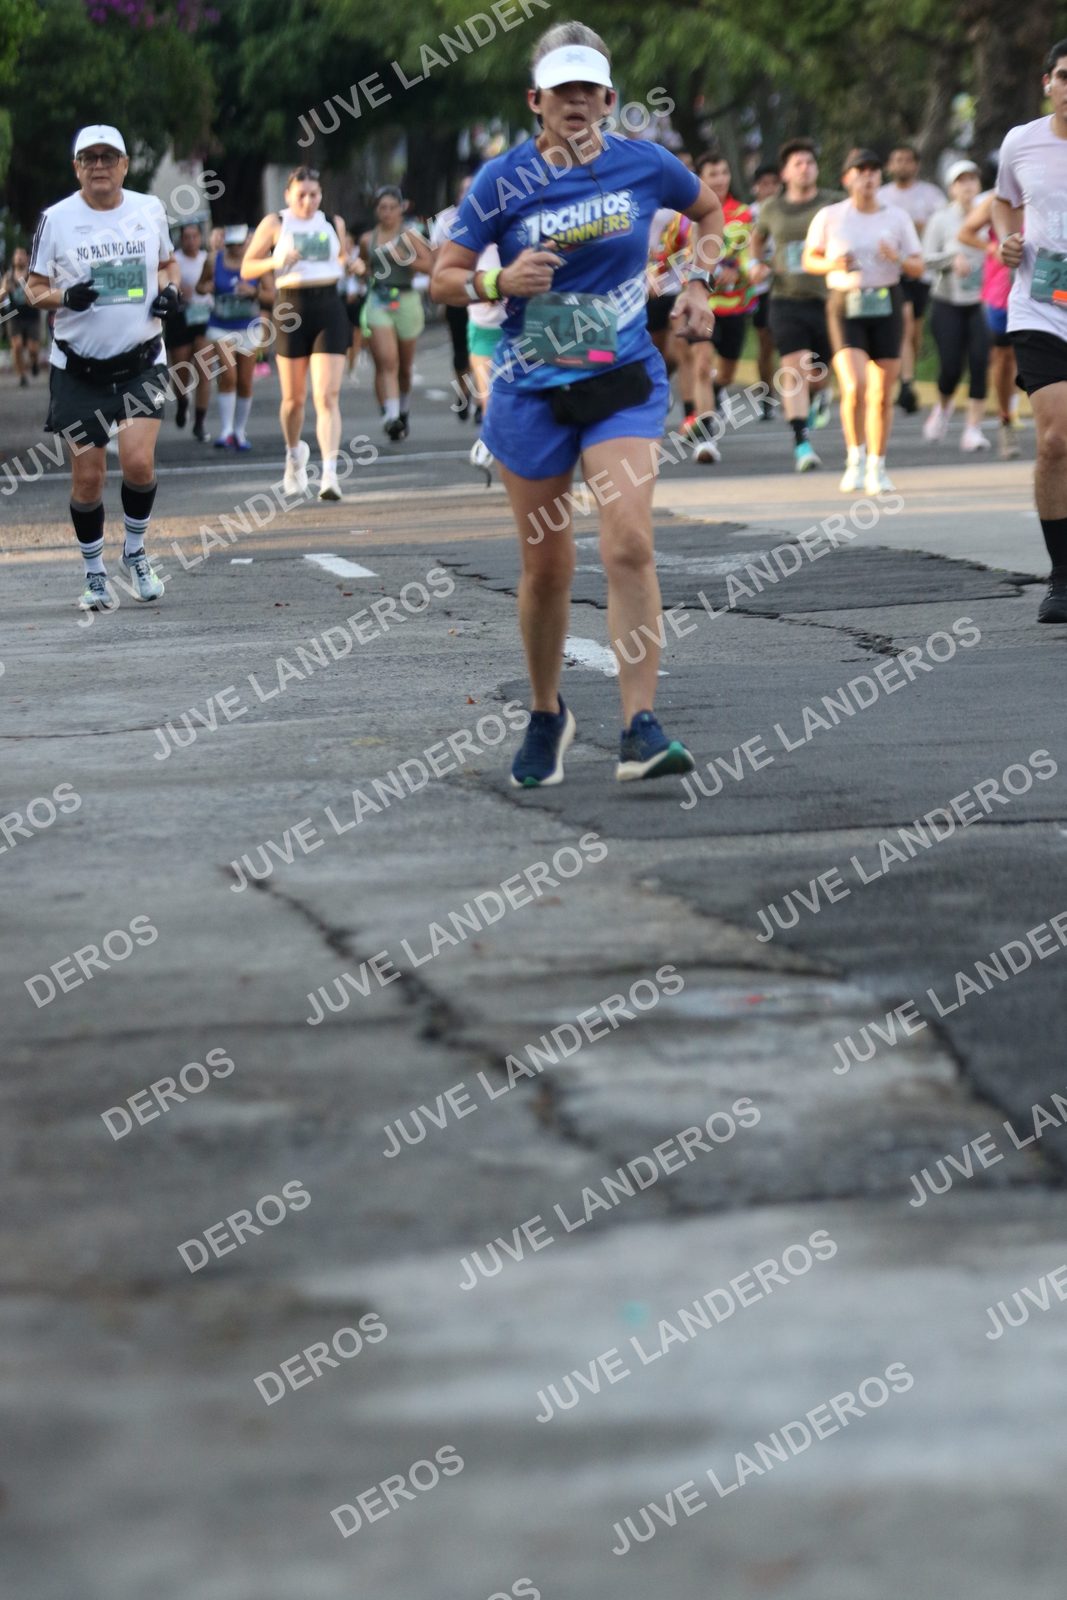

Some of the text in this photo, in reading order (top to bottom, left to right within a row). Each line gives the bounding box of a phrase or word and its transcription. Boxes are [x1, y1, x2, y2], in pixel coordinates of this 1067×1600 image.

[76, 240, 146, 260] NO PAIN NO GAIN
[106, 270, 144, 290] 0621
[1049, 267, 1067, 288] 2
